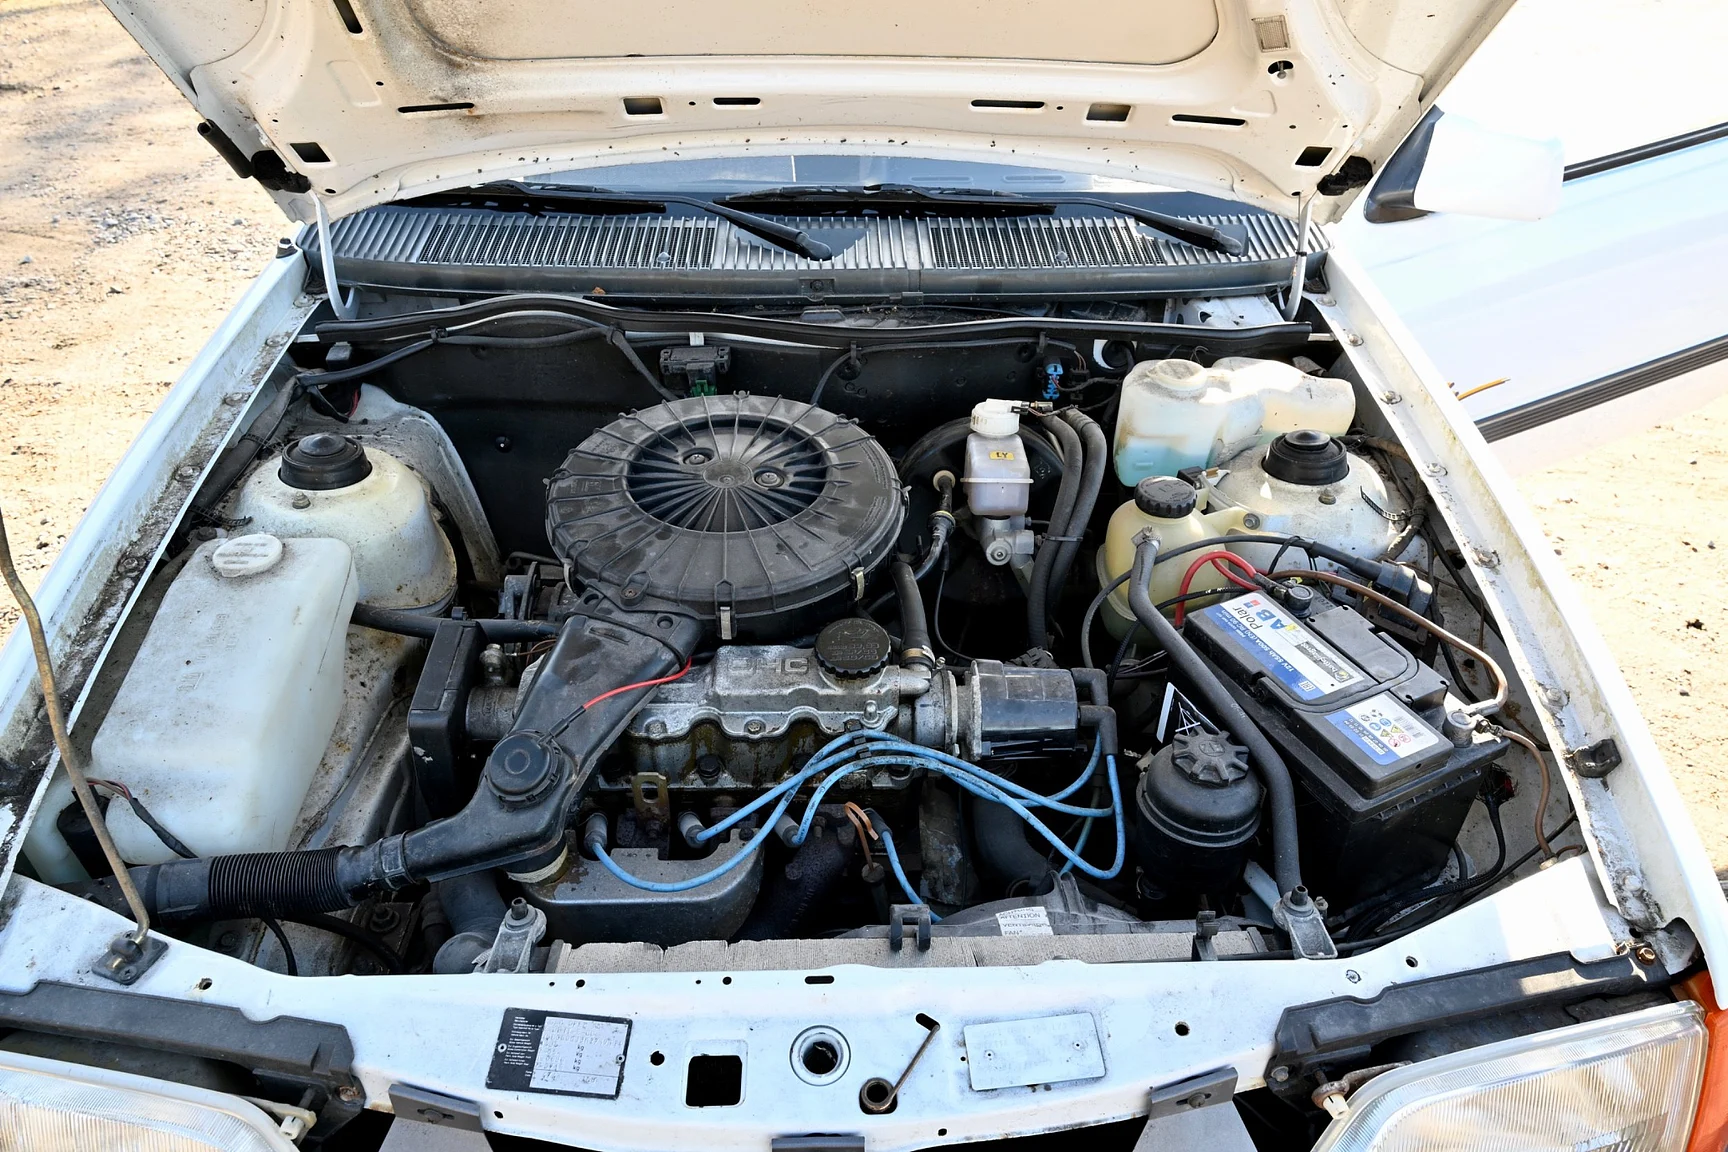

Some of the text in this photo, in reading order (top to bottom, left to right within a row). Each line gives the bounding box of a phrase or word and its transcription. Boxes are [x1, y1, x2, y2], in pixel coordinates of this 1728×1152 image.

[1233, 607, 1263, 630] Polar
[1256, 609, 1287, 630] AB
[728, 657, 809, 673] OHC
[1269, 651, 1284, 663] 55Ah
[1281, 662, 1294, 672] 12V
